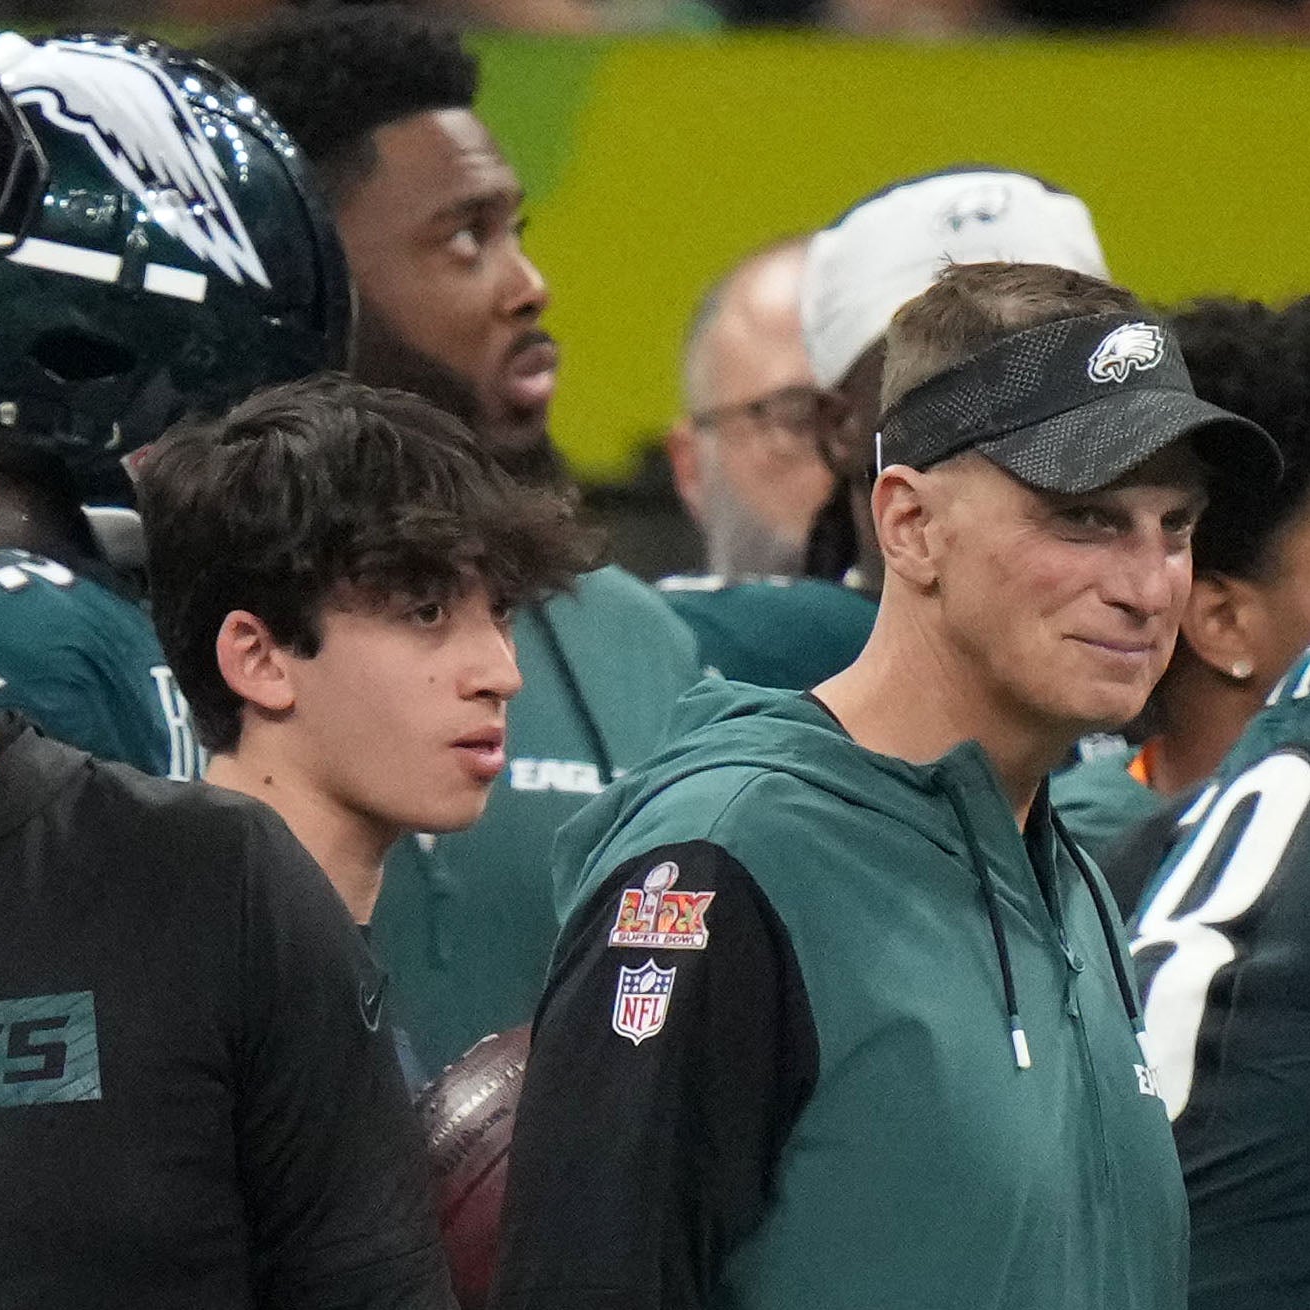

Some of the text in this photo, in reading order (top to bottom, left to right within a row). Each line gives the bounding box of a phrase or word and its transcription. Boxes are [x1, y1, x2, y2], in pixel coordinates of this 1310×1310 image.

[617, 892, 714, 933] LIX
[618, 933, 698, 945] SUPER BOWL
[621, 997, 662, 1031] NFL
